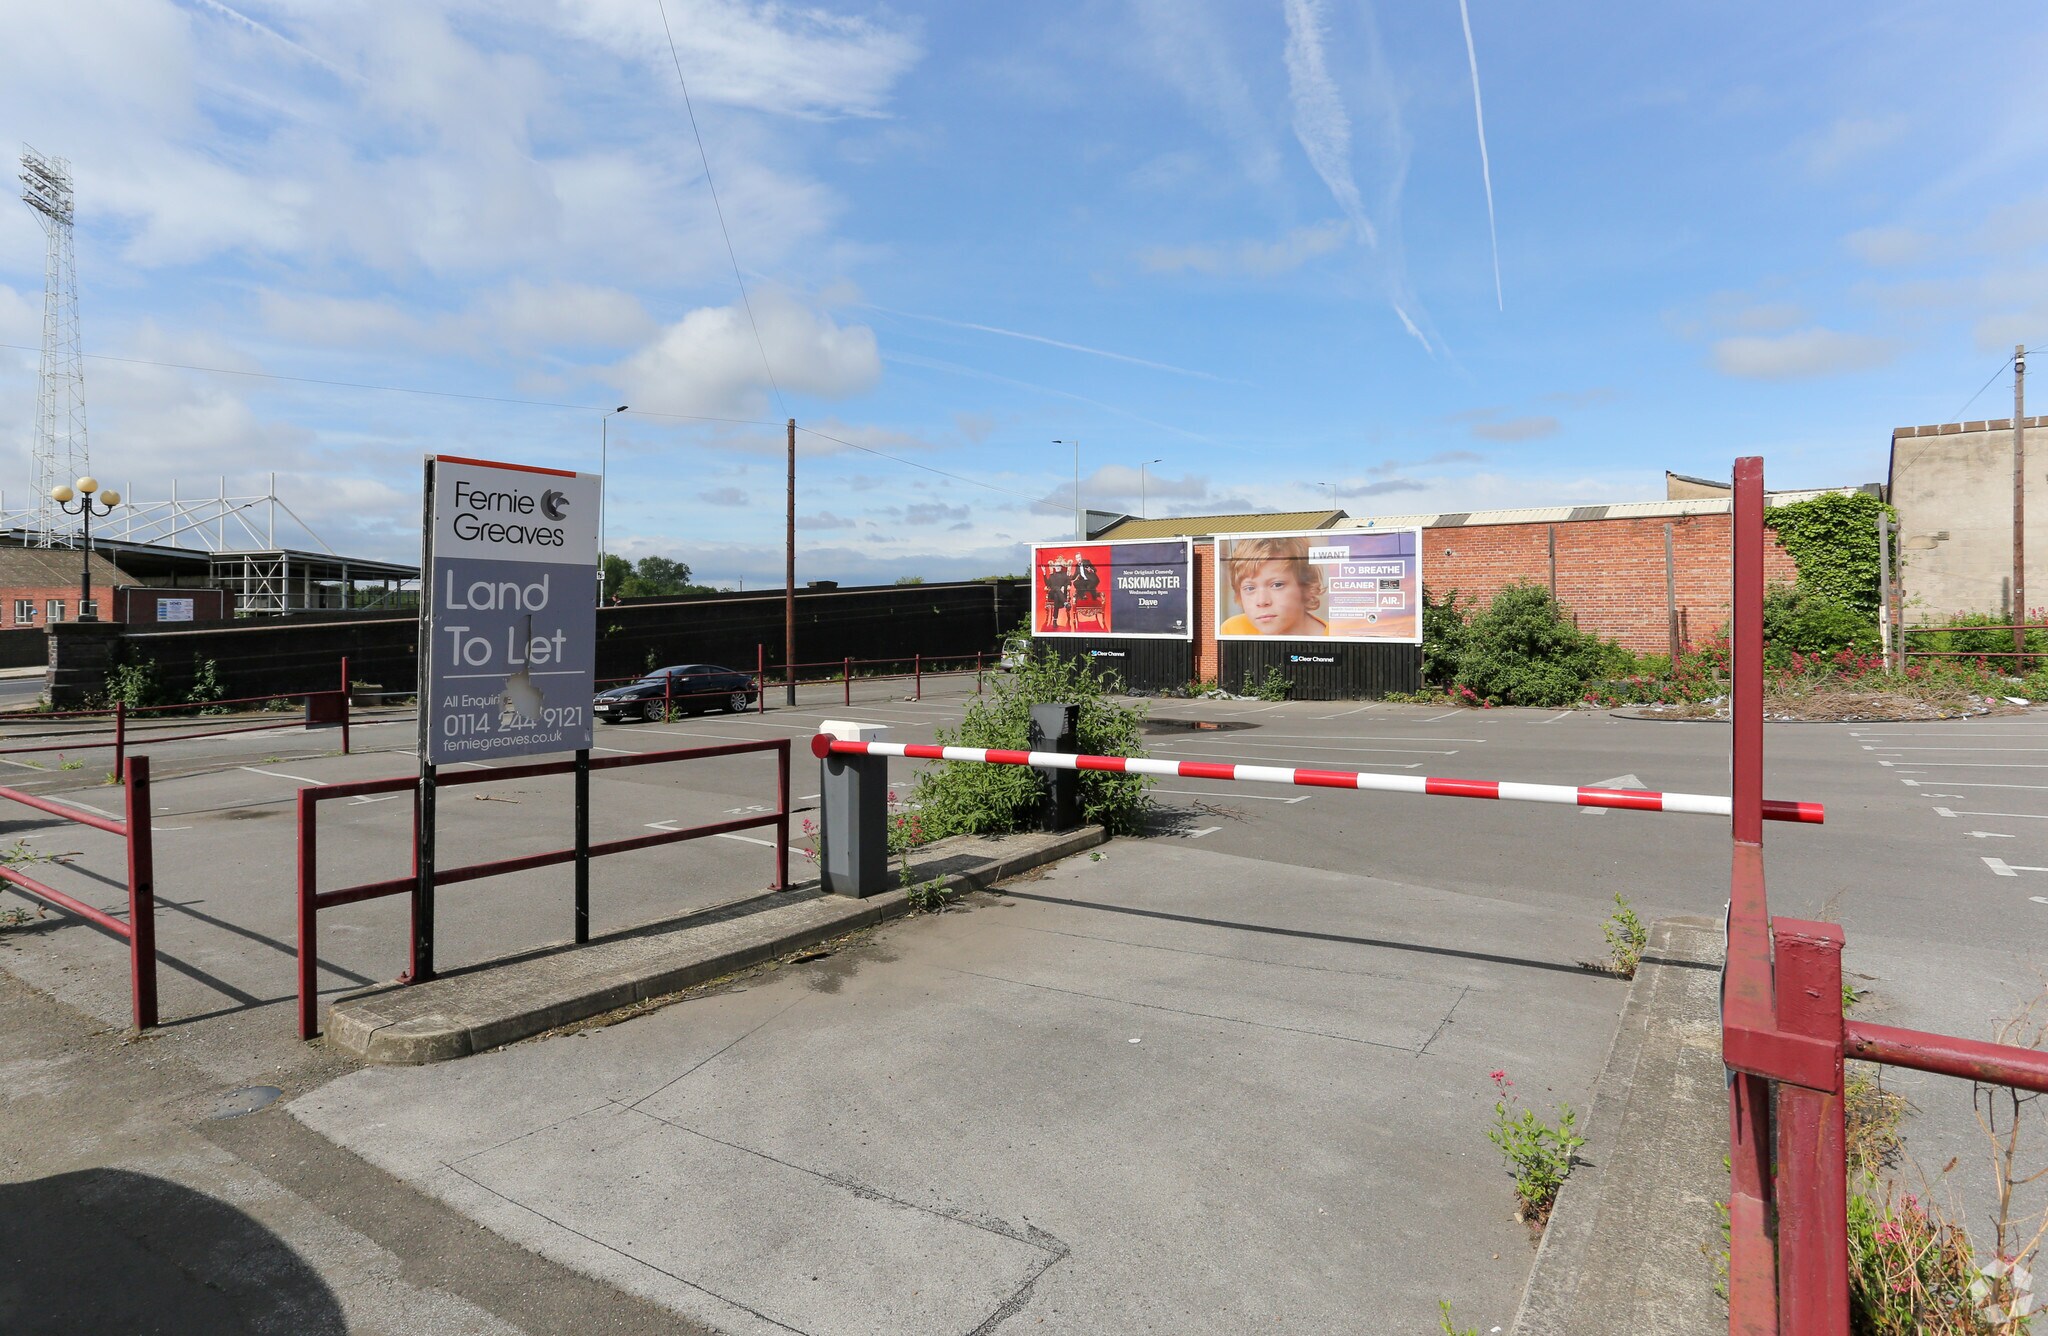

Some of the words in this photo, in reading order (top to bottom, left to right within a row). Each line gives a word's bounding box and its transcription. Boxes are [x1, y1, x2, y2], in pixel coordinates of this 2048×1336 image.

[455, 481, 535, 515] Fernie
[453, 512, 565, 547] Greaves
[1318, 551, 1346, 560] WANT
[1343, 566, 1356, 574] TO
[1358, 565, 1400, 574] BREATHE
[446, 569, 549, 612] Land
[1117, 576, 1180, 589] TASKMASTER
[1332, 581, 1375, 589] CLEANER
[1138, 598, 1158, 606] Dave
[1380, 596, 1400, 605] AIR.
[443, 626, 493, 666] To
[507, 626, 567, 665] Let
[443, 695, 458, 708] All
[461, 693, 501, 709] Enquiri
[443, 712, 491, 737] 0114
[543, 706, 583, 729] 9121
[443, 730, 563, 752] ferniegreaves.co.uk
